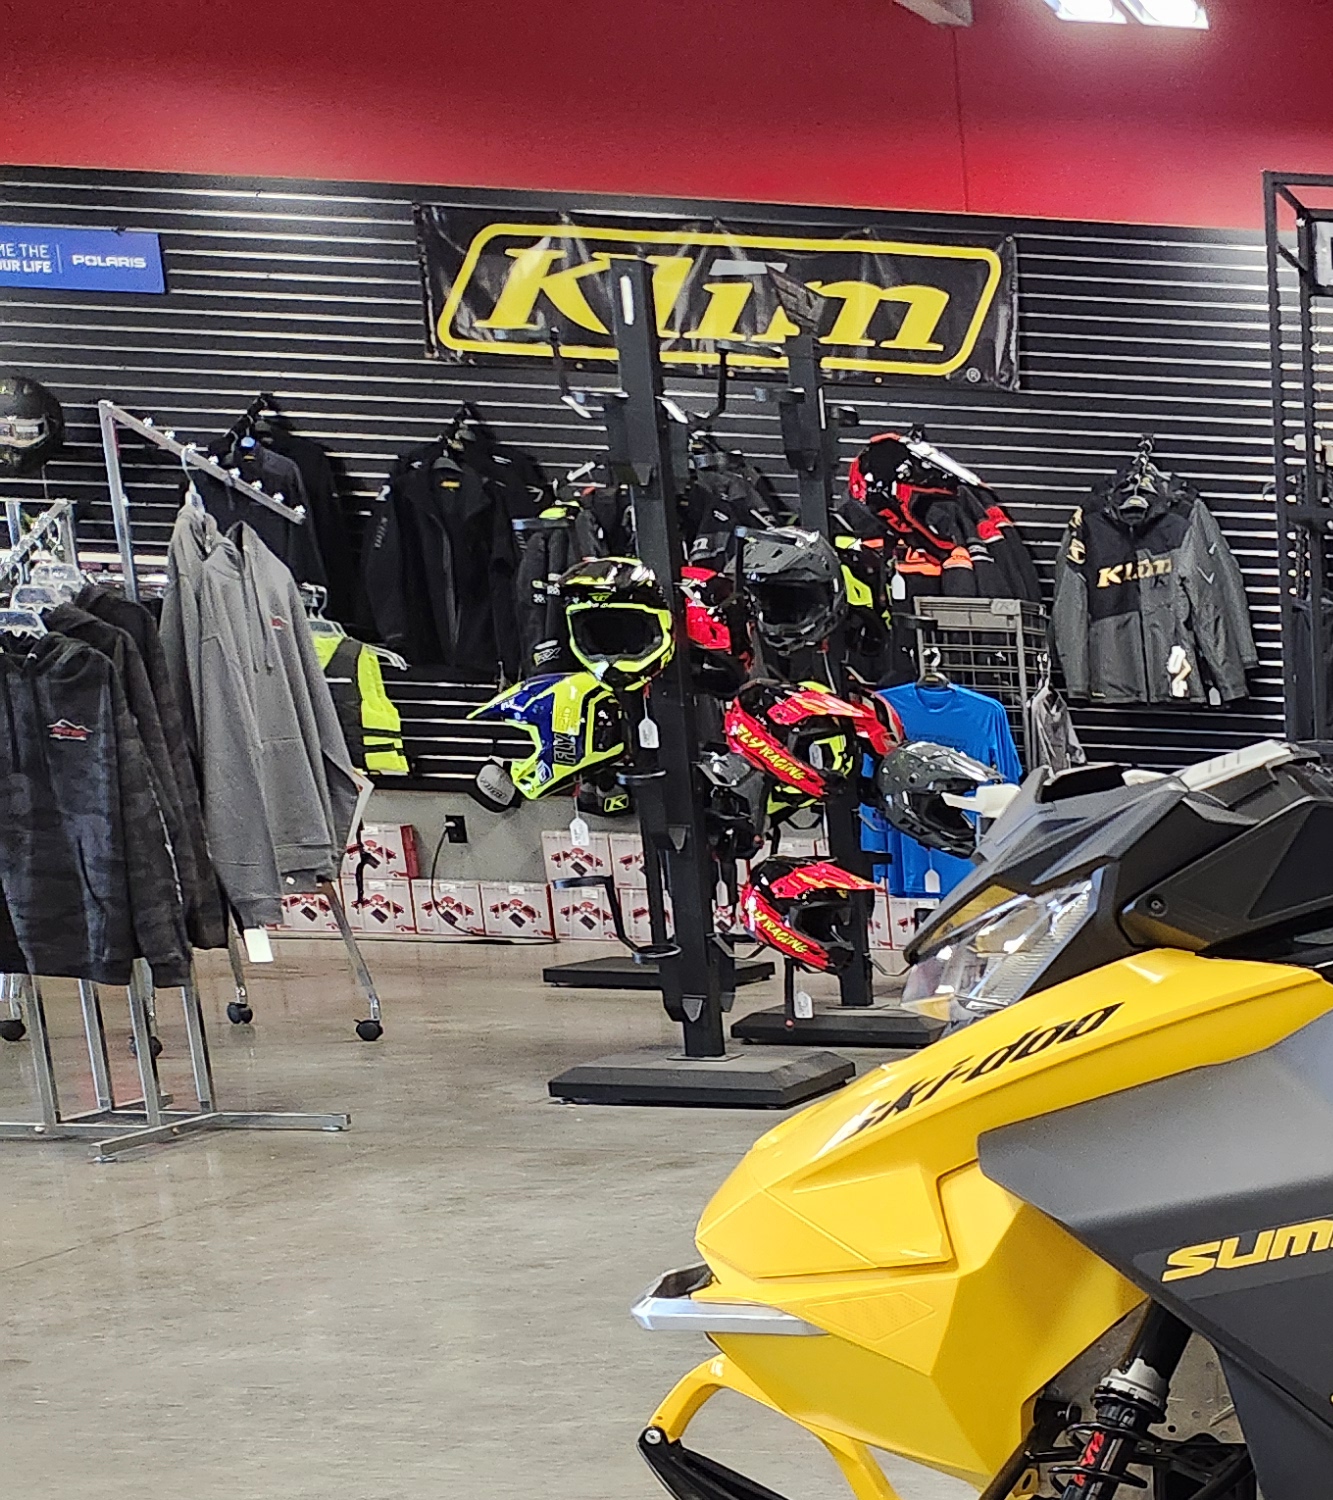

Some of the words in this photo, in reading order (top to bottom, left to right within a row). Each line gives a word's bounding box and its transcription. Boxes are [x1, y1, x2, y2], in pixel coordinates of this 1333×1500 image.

[18, 243, 49, 258] THE
[22, 260, 52, 274] LIFE
[71, 254, 147, 269] POLARIS
[554, 734, 577, 764] FLY
